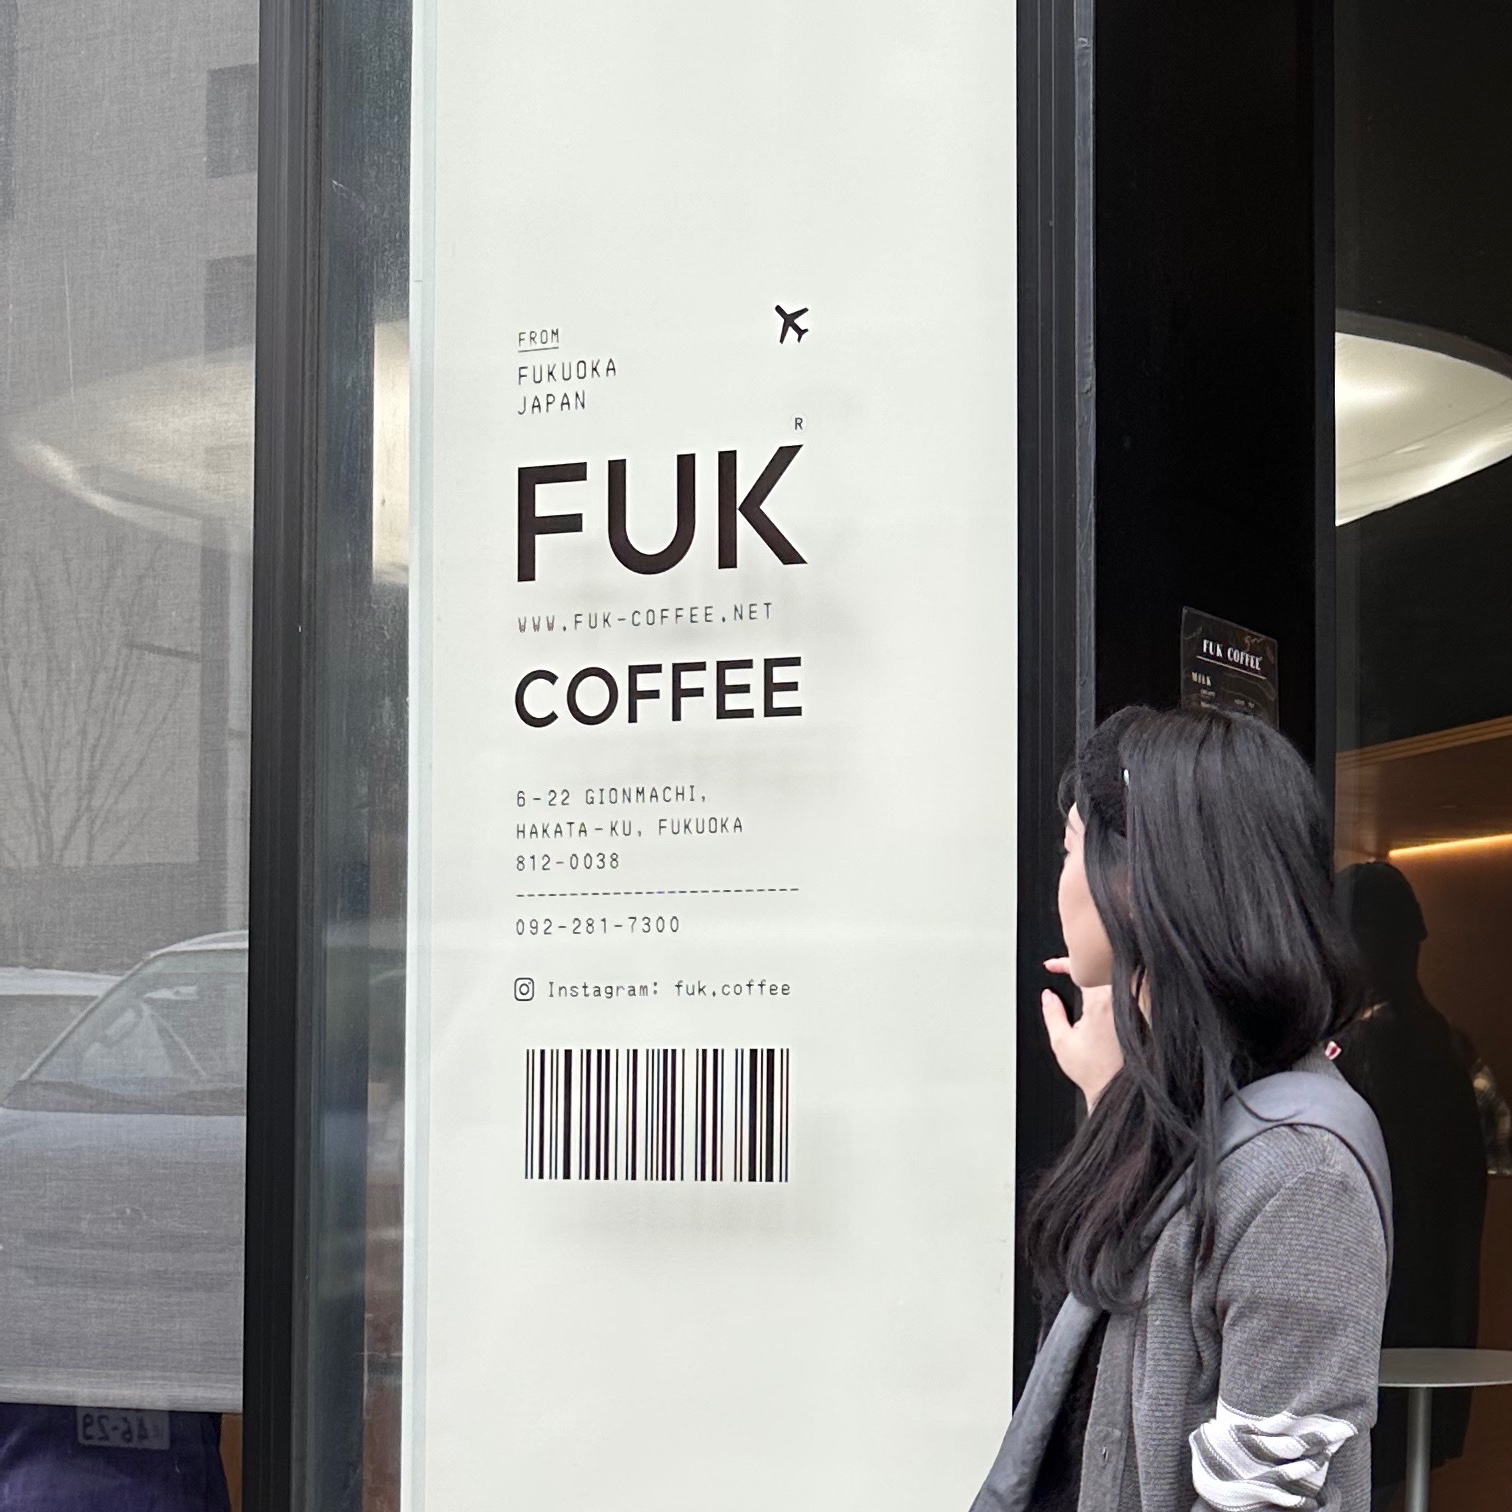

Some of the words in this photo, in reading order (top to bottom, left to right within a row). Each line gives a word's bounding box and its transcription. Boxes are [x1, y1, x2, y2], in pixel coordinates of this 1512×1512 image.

[518, 328, 560, 347] FROM
[518, 358, 617, 385] FUKUOKA
[517, 390, 586, 415] JAPAN
[517, 444, 808, 582] FUK
[518, 603, 773, 633] WWW.FUK-COFFEE.NET
[1202, 638, 1223, 658] FUK
[1227, 647, 1263, 671] COFFEE
[514, 656, 803, 728] COFFEE
[516, 789, 570, 807] 6-22
[585, 785, 707, 805] GIONMACHI,
[516, 820, 643, 839] HAKATA-KU,
[658, 816, 743, 836] FUKUOKA
[516, 852, 620, 872] 812-0038
[516, 916, 680, 935] 092-281-7300
[549, 981, 659, 999] Instagram:
[675, 978, 791, 997] fuk.coffee
